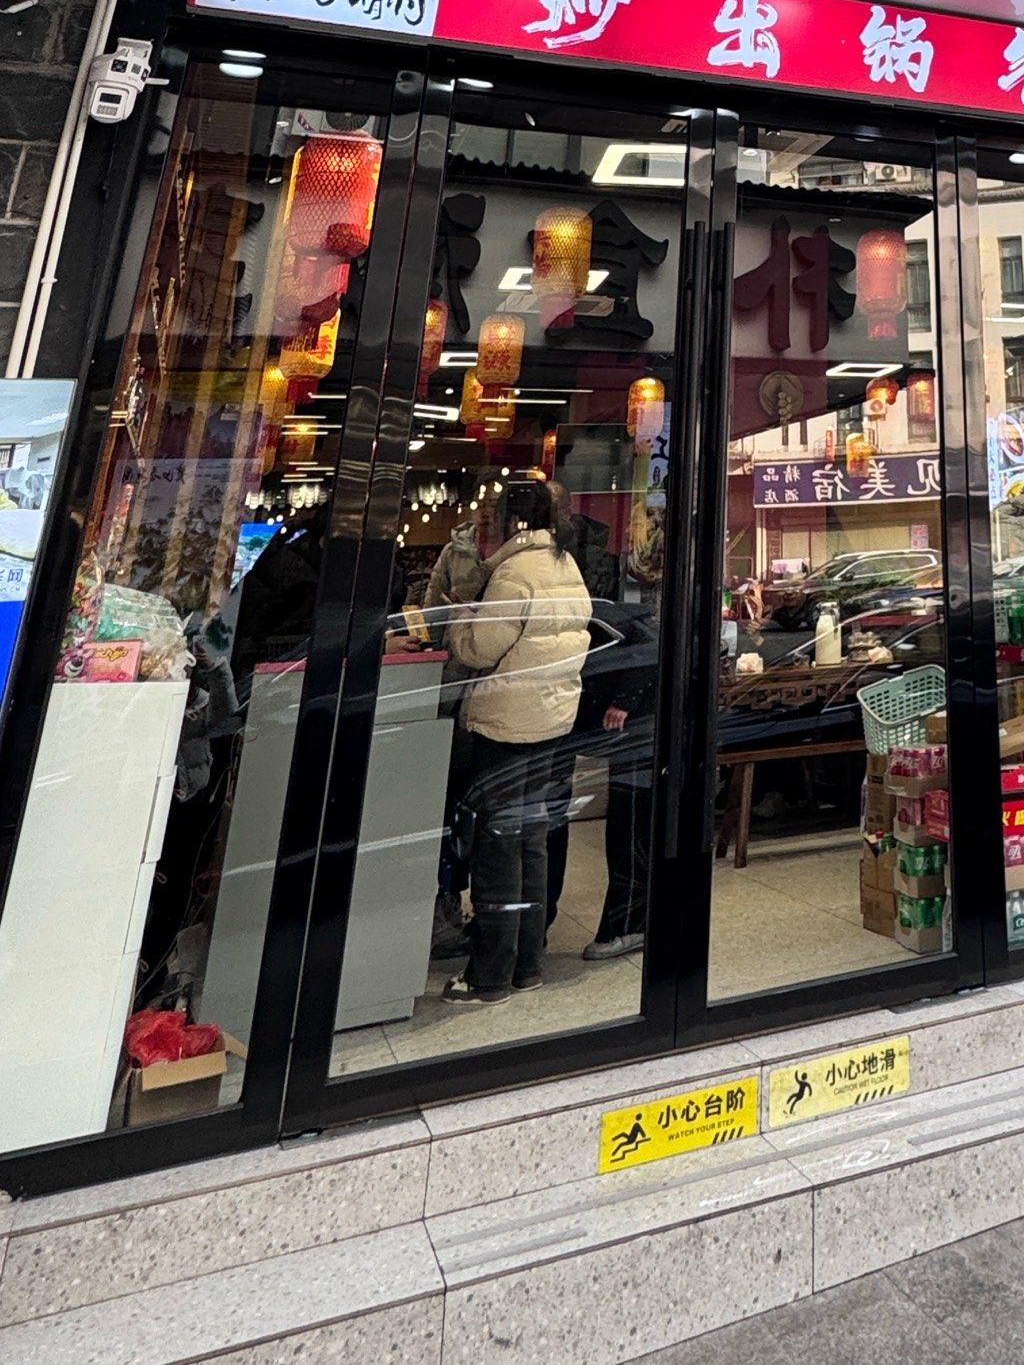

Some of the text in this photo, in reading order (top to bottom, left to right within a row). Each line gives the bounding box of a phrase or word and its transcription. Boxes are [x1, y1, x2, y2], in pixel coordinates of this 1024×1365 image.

[825, 1048, 896, 1087] 小心地滑
[657, 1086, 746, 1130] 小心台阶
[667, 1117, 735, 1142] WATCH YOUR STEP
